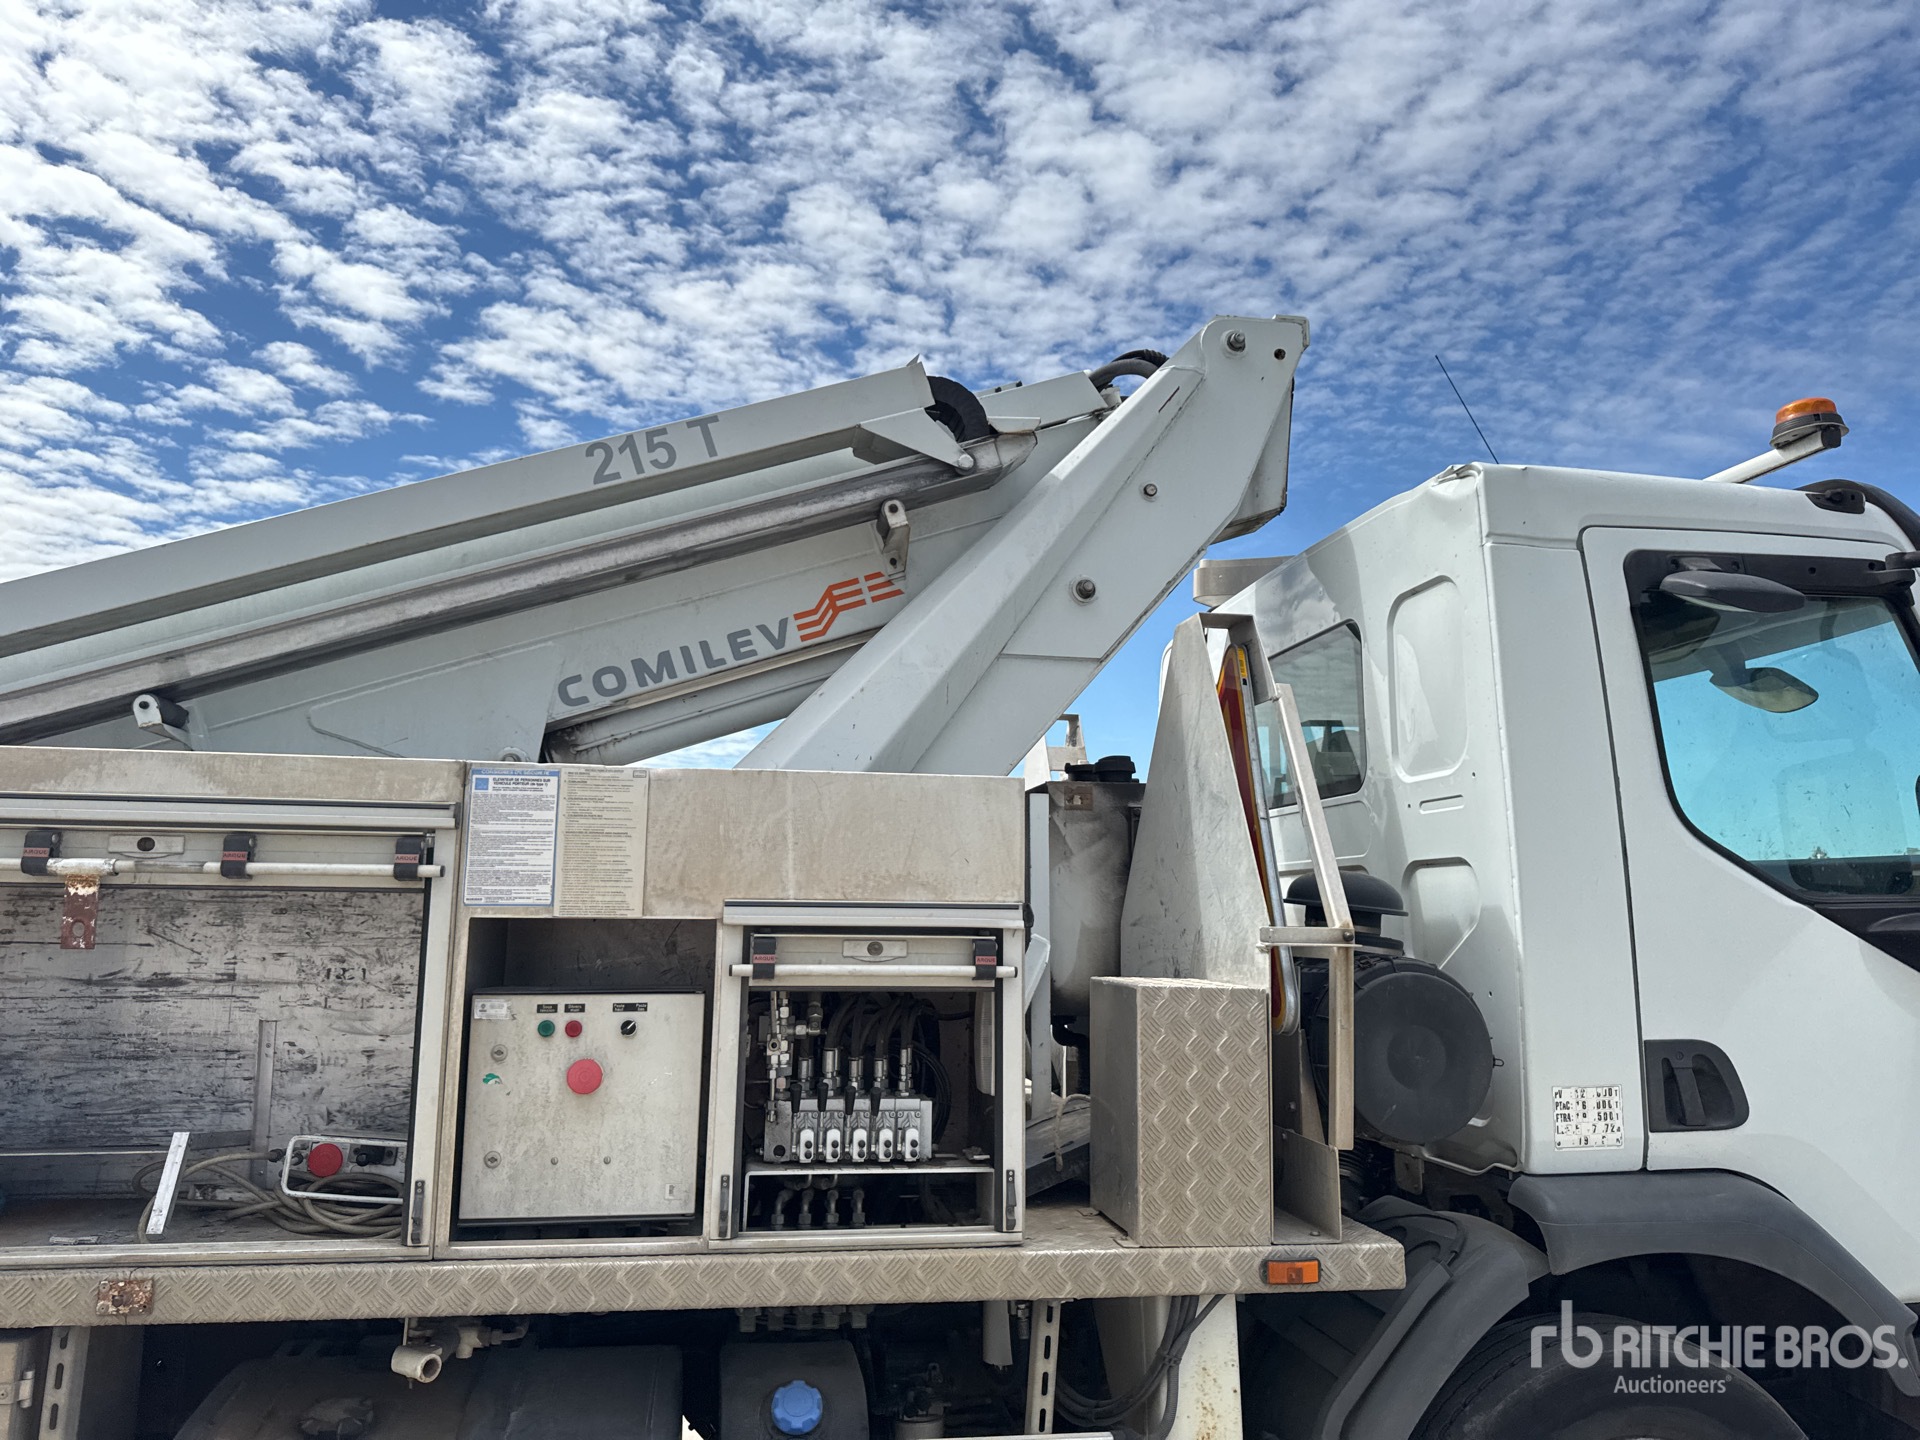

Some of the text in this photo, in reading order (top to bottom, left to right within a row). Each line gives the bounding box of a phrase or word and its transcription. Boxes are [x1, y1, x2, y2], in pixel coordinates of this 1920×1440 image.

[585, 415, 720, 485] 215 T
[557, 617, 789, 706] COMILEV
